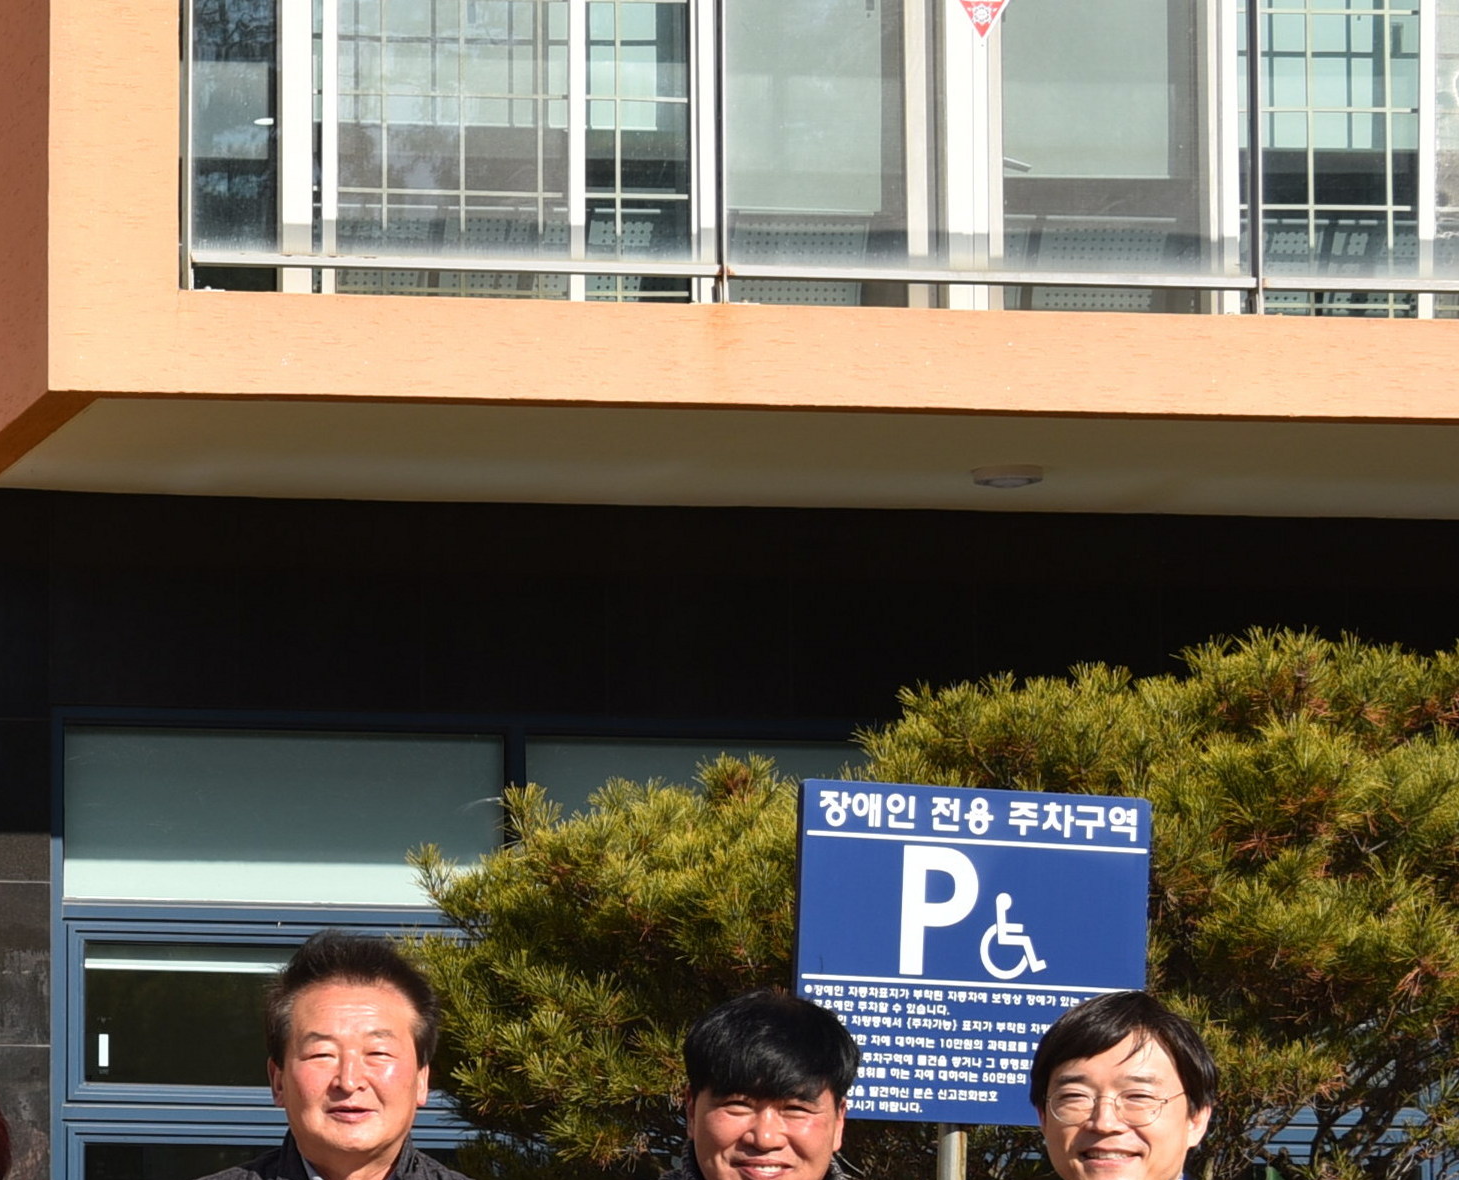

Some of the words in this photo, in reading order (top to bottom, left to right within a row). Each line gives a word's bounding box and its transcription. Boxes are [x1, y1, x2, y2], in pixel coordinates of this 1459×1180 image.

[820, 790, 915, 828] 장애인
[931, 796, 993, 835] 전용
[1009, 801, 1137, 841] 주차구역
[899, 845, 979, 975] P
